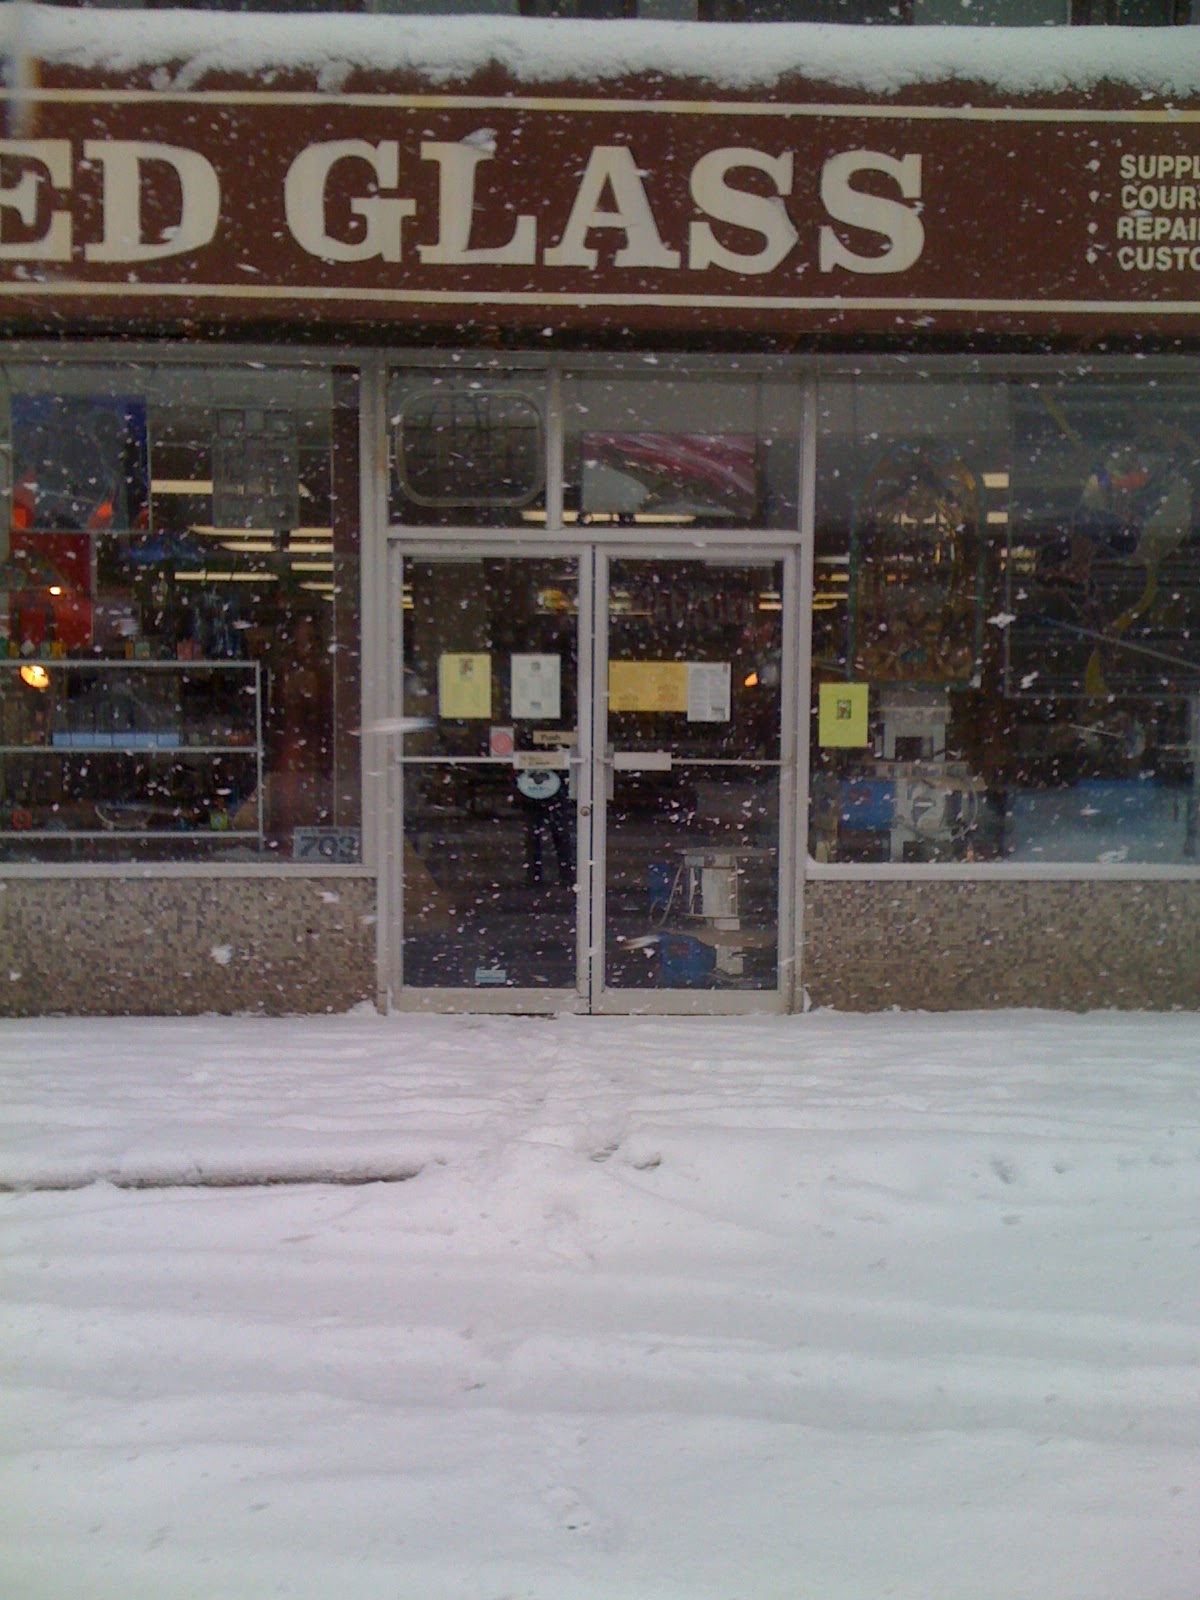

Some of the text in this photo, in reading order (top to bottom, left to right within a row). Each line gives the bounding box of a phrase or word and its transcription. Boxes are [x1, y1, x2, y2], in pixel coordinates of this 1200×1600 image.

[284, 139, 925, 275] GLASS
[1121, 184, 1200, 210] COUR
[1117, 215, 1200, 241] REPAI
